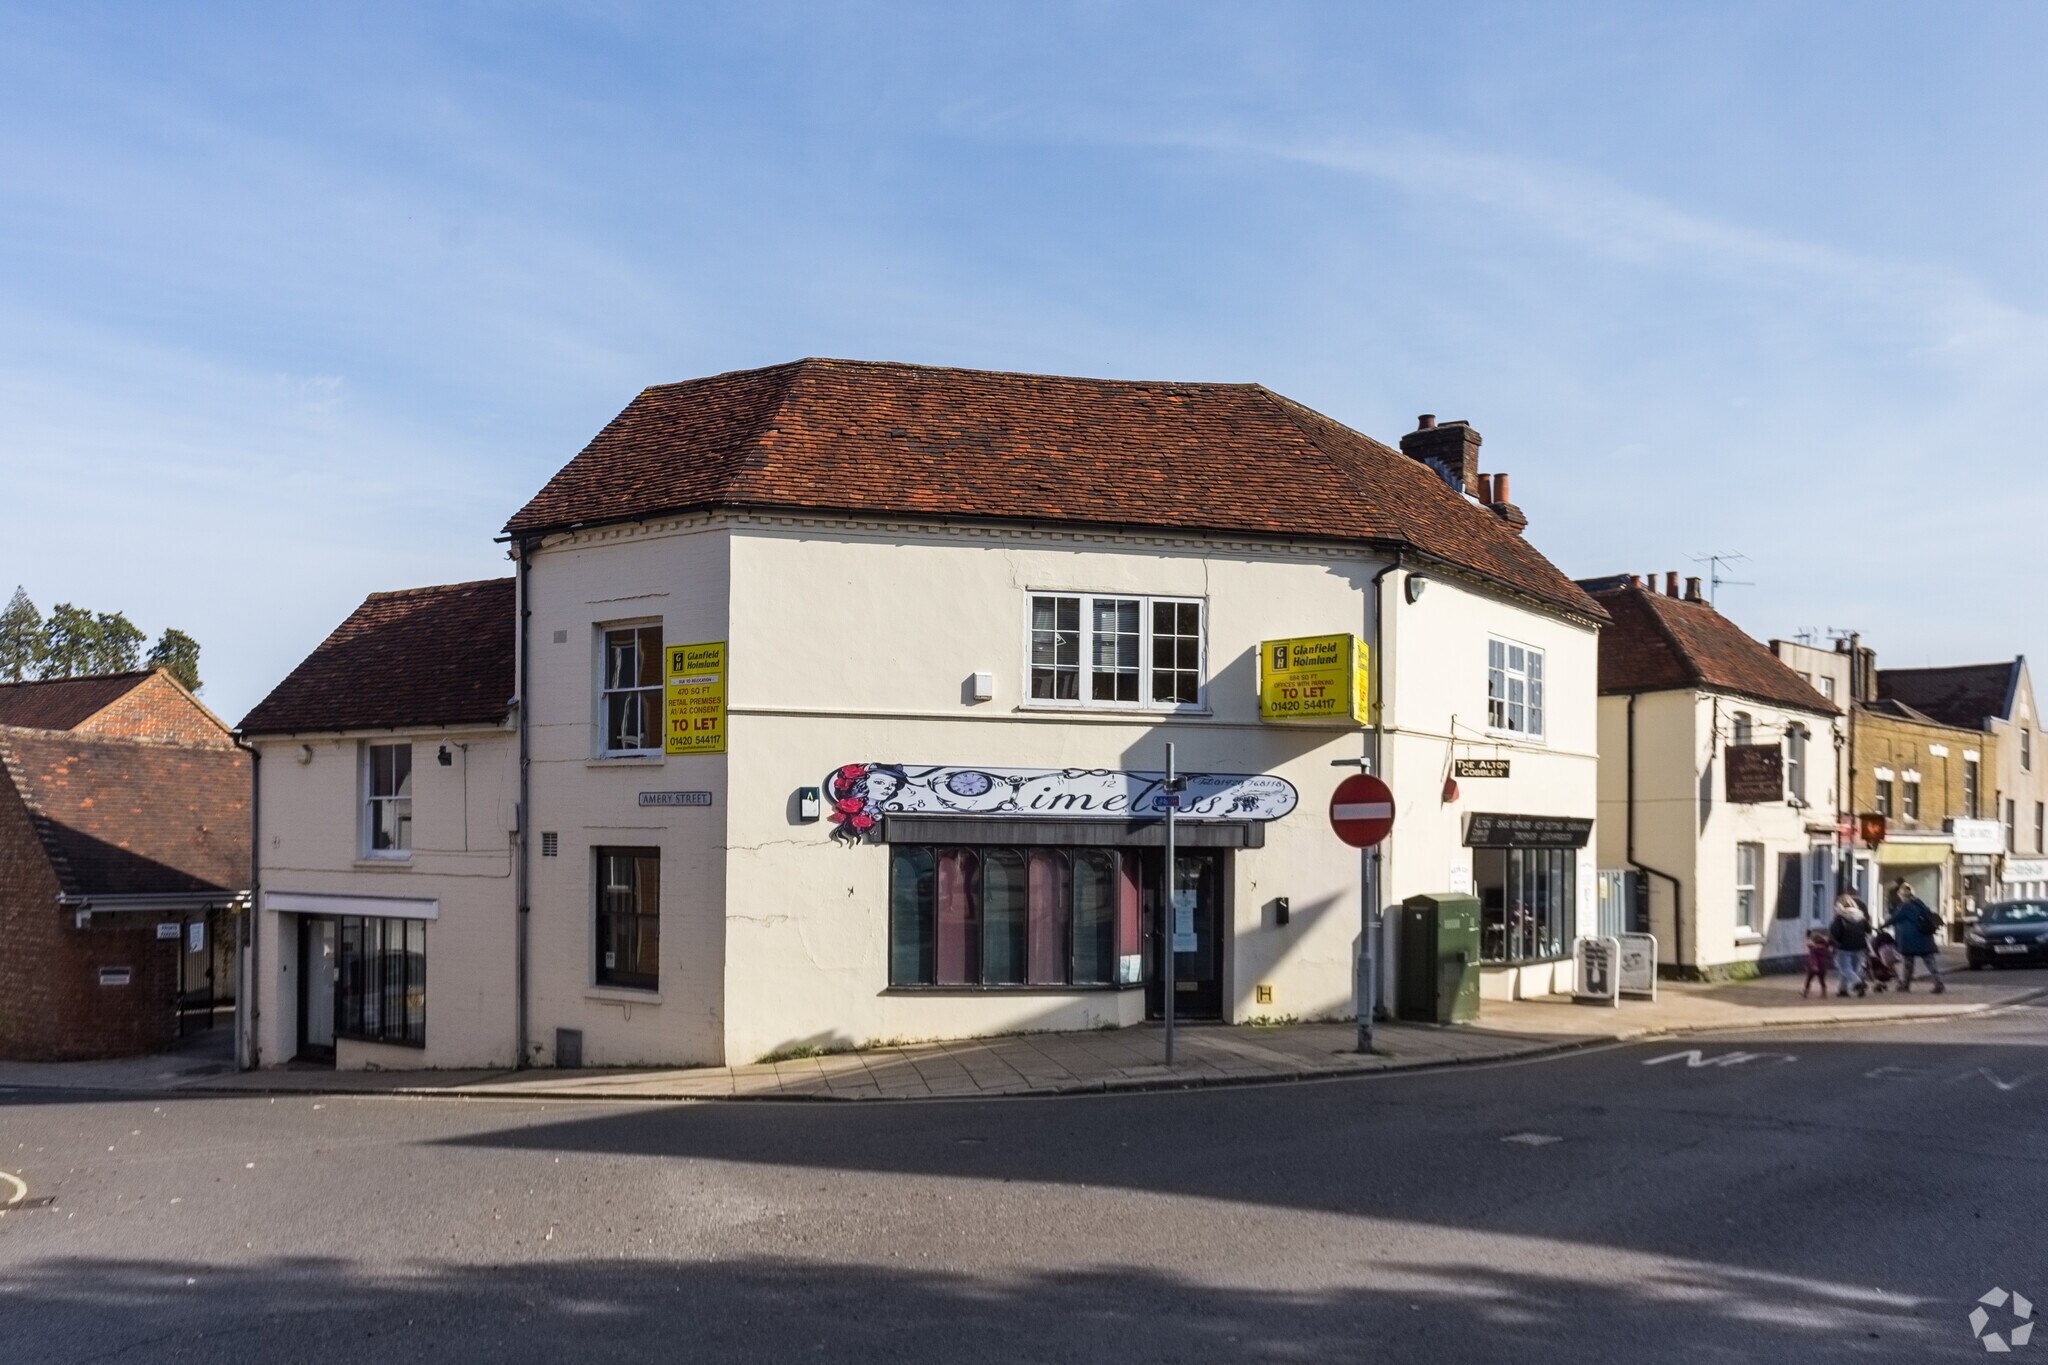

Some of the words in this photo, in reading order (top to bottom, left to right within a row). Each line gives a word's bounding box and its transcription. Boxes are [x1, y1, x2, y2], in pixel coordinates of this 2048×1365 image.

[687, 650, 720, 660] Glanfield
[1293, 642, 1337, 656] Glanfield
[686, 660, 720, 670] Holmlund
[1293, 654, 1338, 667] Holmlund
[677, 688, 689, 696] 470
[690, 687, 701, 695] SQ
[702, 686, 711, 694] FT
[1281, 688, 1299, 699] TO
[1303, 686, 1326, 698] LET
[668, 698, 688, 707] RETAIL
[689, 696, 722, 705] PREMISES
[1271, 700, 1300, 712] 01420
[1303, 698, 1336, 710] 544117
[670, 707, 688, 716] A1/A2
[689, 706, 720, 714] CONSENT
[671, 718, 689, 732] TO
[694, 717, 718, 731] LET
[670, 735, 693, 746] 01420
[695, 734, 721, 745] 544117
[1457, 760, 1476, 769] THE
[1478, 760, 1509, 769] ALTON
[1461, 768, 1504, 777] COBBLER
[642, 793, 673, 805] AMERY
[675, 792, 708, 804] STREET
[1260, 986, 1271, 1001] H
